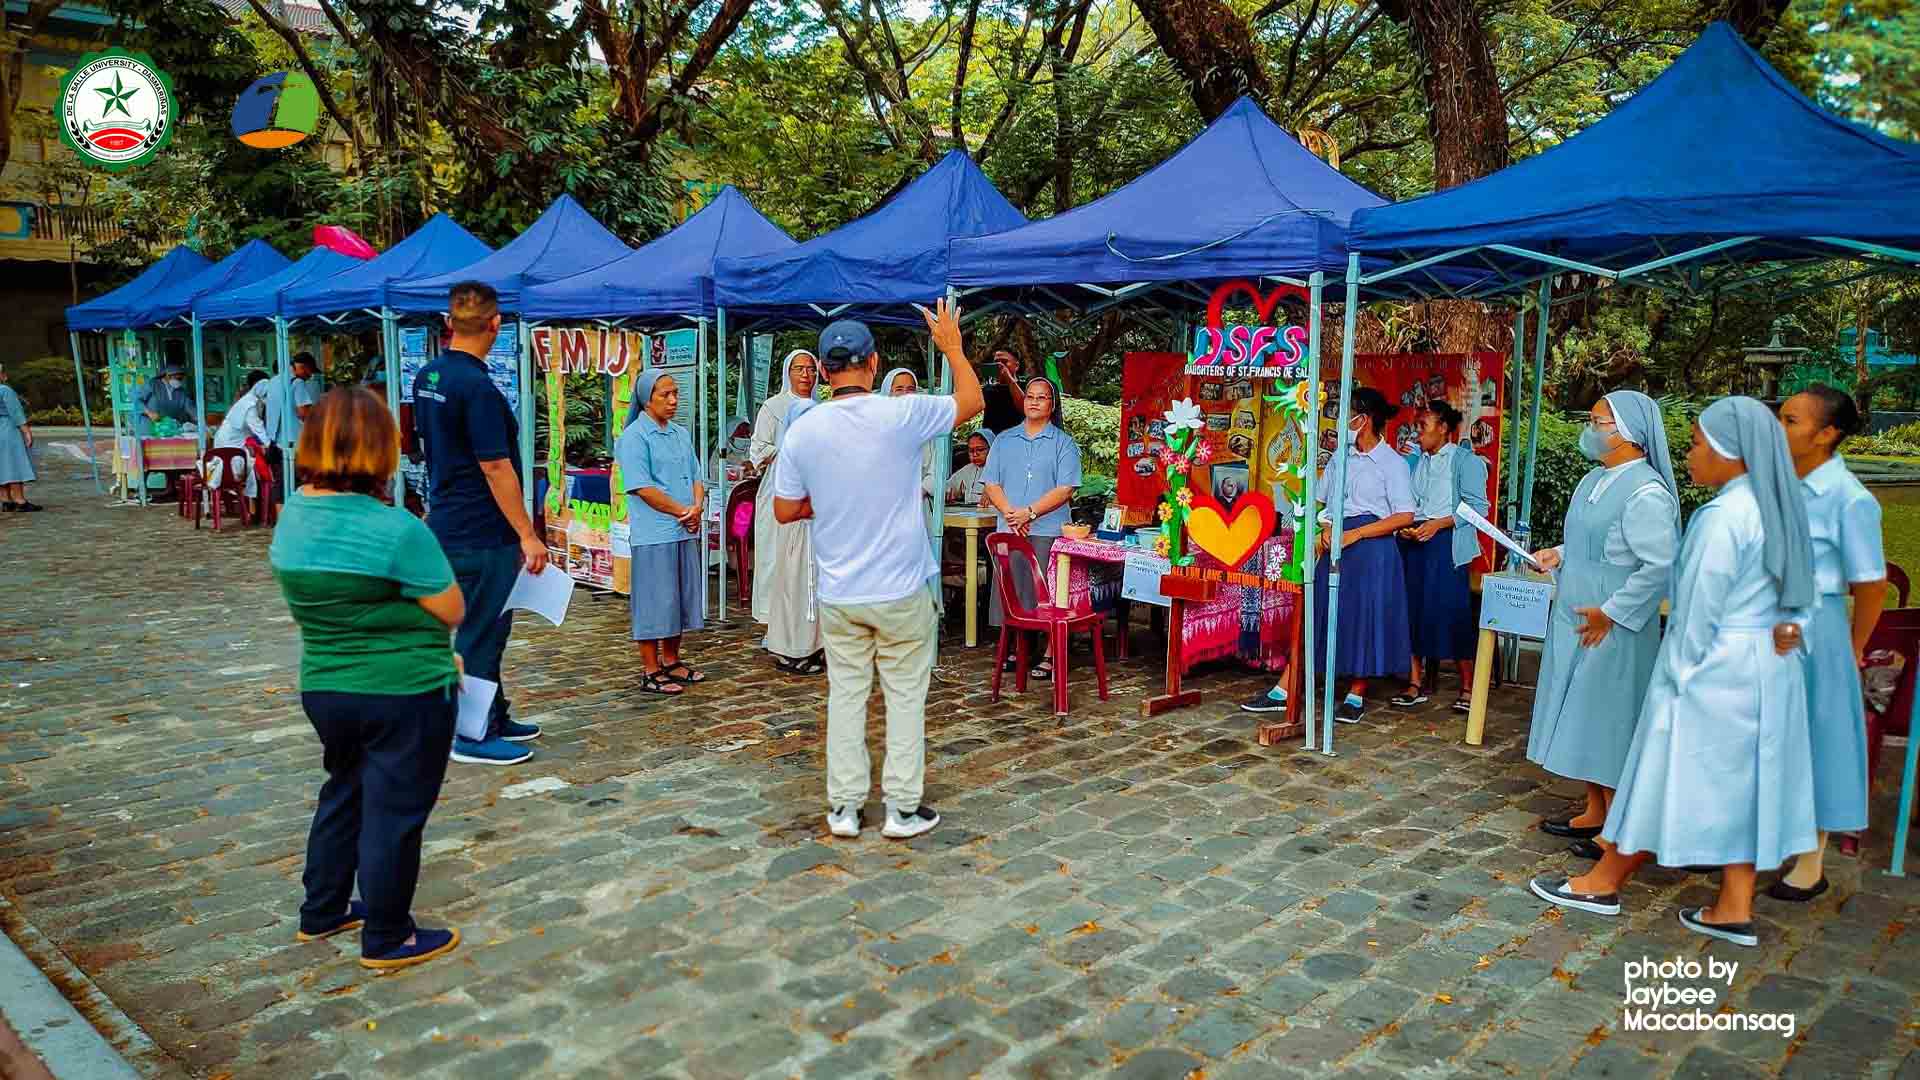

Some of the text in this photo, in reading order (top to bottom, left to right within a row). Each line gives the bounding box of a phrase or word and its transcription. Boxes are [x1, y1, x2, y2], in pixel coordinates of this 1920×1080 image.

[530, 326, 630, 376] FMIJ
[1184, 364, 1225, 377] DAUGHTERS
[1226, 365, 1236, 377] OF
[1295, 367, 1312, 379] SAL
